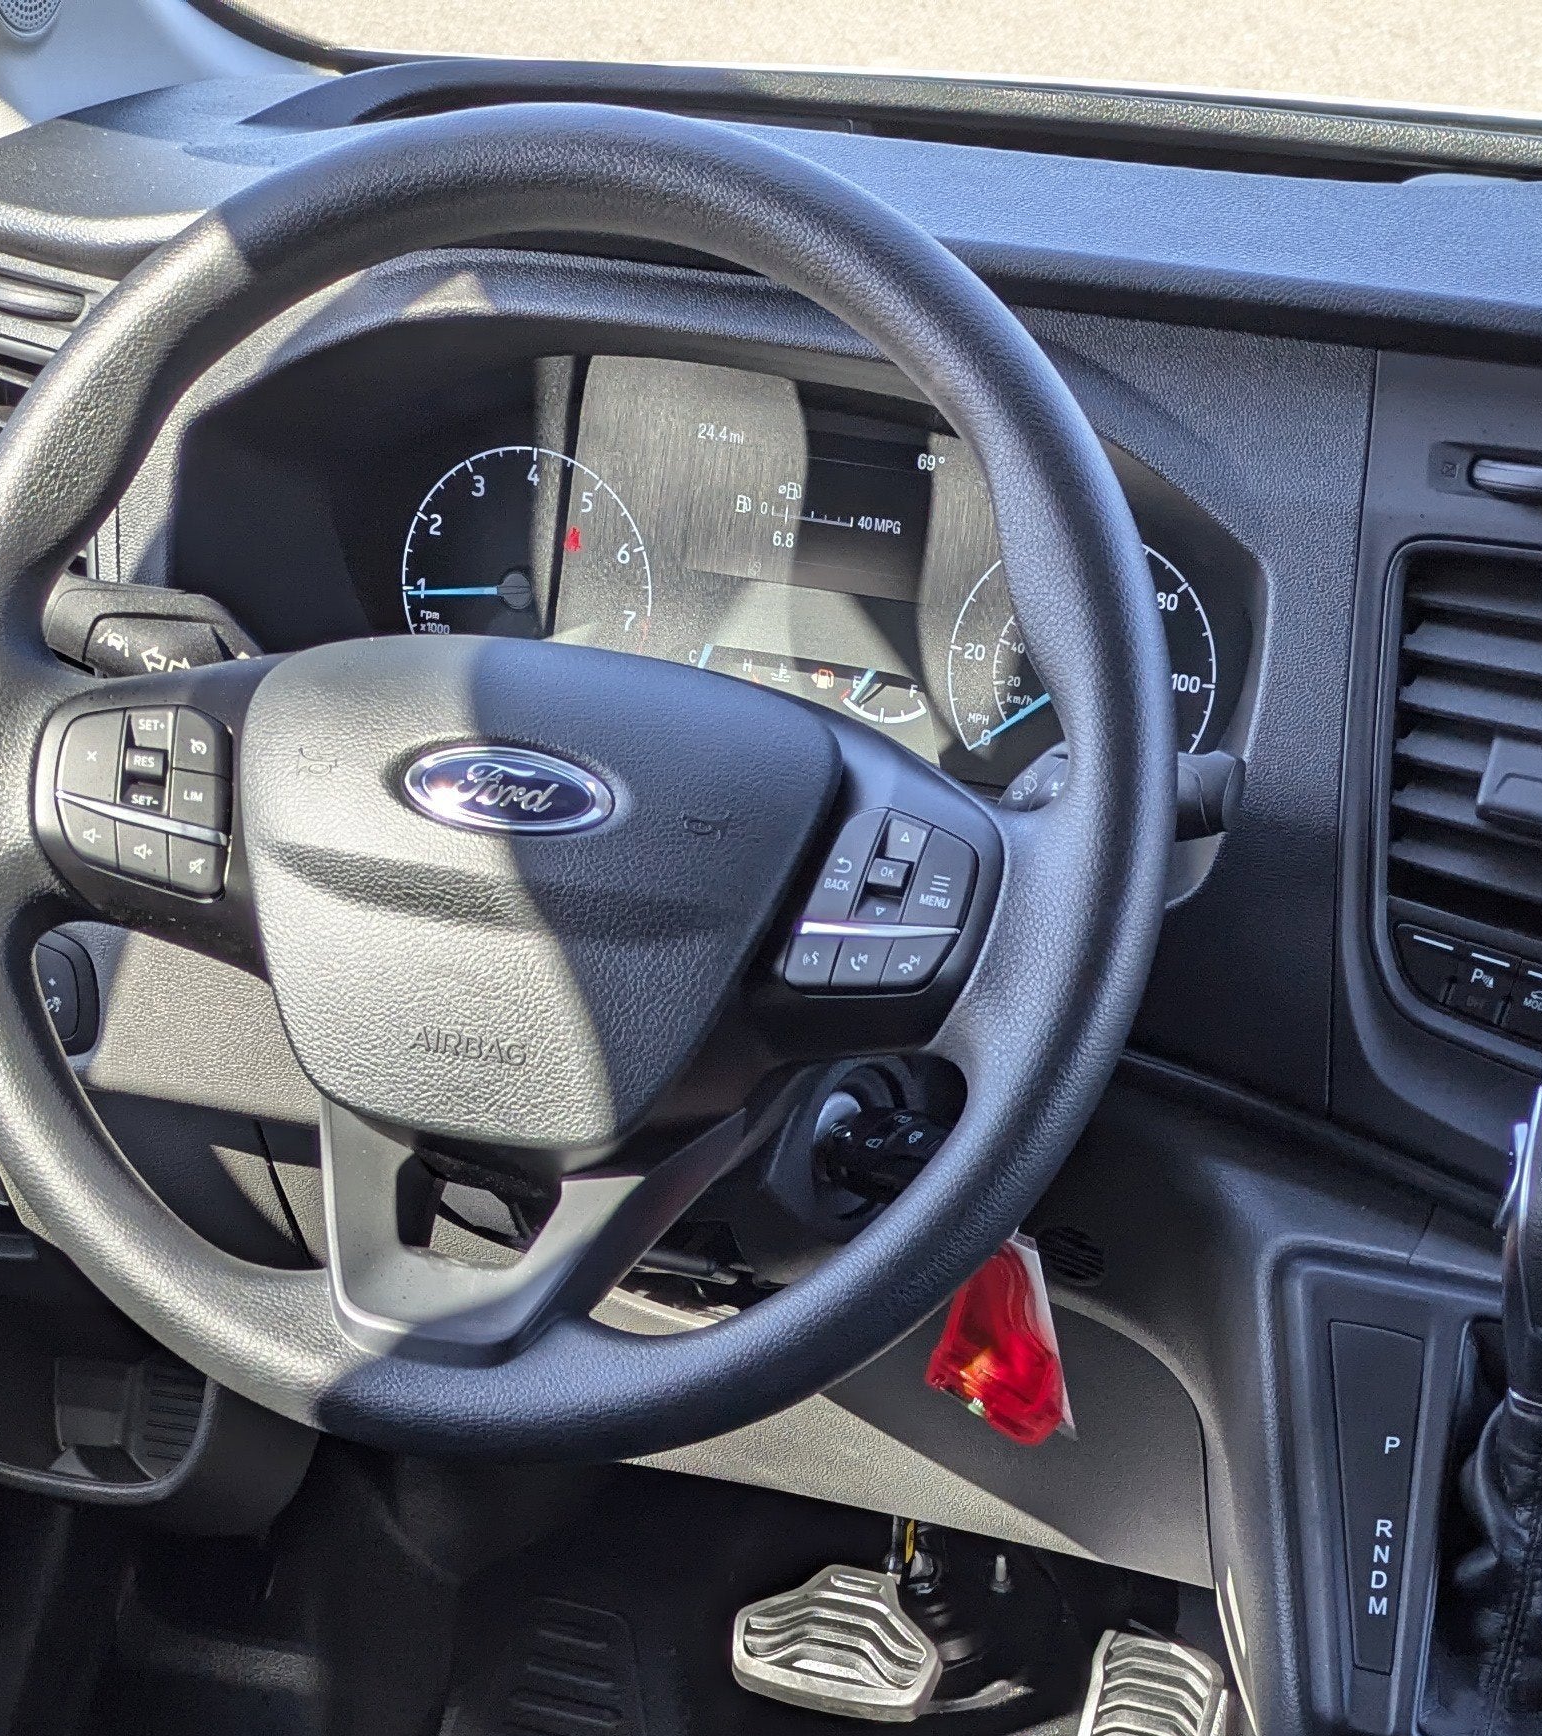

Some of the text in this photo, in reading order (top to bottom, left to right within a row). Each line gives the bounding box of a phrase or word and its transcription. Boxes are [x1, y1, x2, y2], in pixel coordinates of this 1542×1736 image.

[697, 423, 728, 442] 24.4
[527, 465, 539, 486] 4
[471, 475, 485, 497] 3
[581, 492, 593, 513] 5
[429, 514, 442, 536] 2
[858, 516, 902, 535] 40 MPG
[772, 531, 794, 548] 6.8
[617, 543, 630, 565] 6
[1157, 593, 1179, 611] 80
[420, 610, 440, 620] rpm
[624, 610, 636, 631] 7
[420, 623, 450, 634] x1000
[689, 650, 697, 663] C
[964, 642, 986, 661] 20
[1011, 642, 1026, 654] 40
[743, 659, 753, 672] H
[909, 684, 919, 698] F
[1007, 676, 1021, 688] 20
[1171, 673, 1201, 693] 100
[966, 712, 990, 725] MPH
[133, 755, 155, 767] RES
[183, 790, 203, 803] LIM
[456, 762, 559, 813] Ford
[880, 866, 896, 879] OK
[823, 877, 850, 891] BACK
[919, 894, 951, 909] MENU
[409, 1026, 527, 1067] AIRBAG
[1384, 1436, 1401, 1455] P
[1375, 1519, 1393, 1539] R
[1373, 1545, 1390, 1564] N
[1370, 1570, 1388, 1589] D
[1368, 1596, 1388, 1616] M
